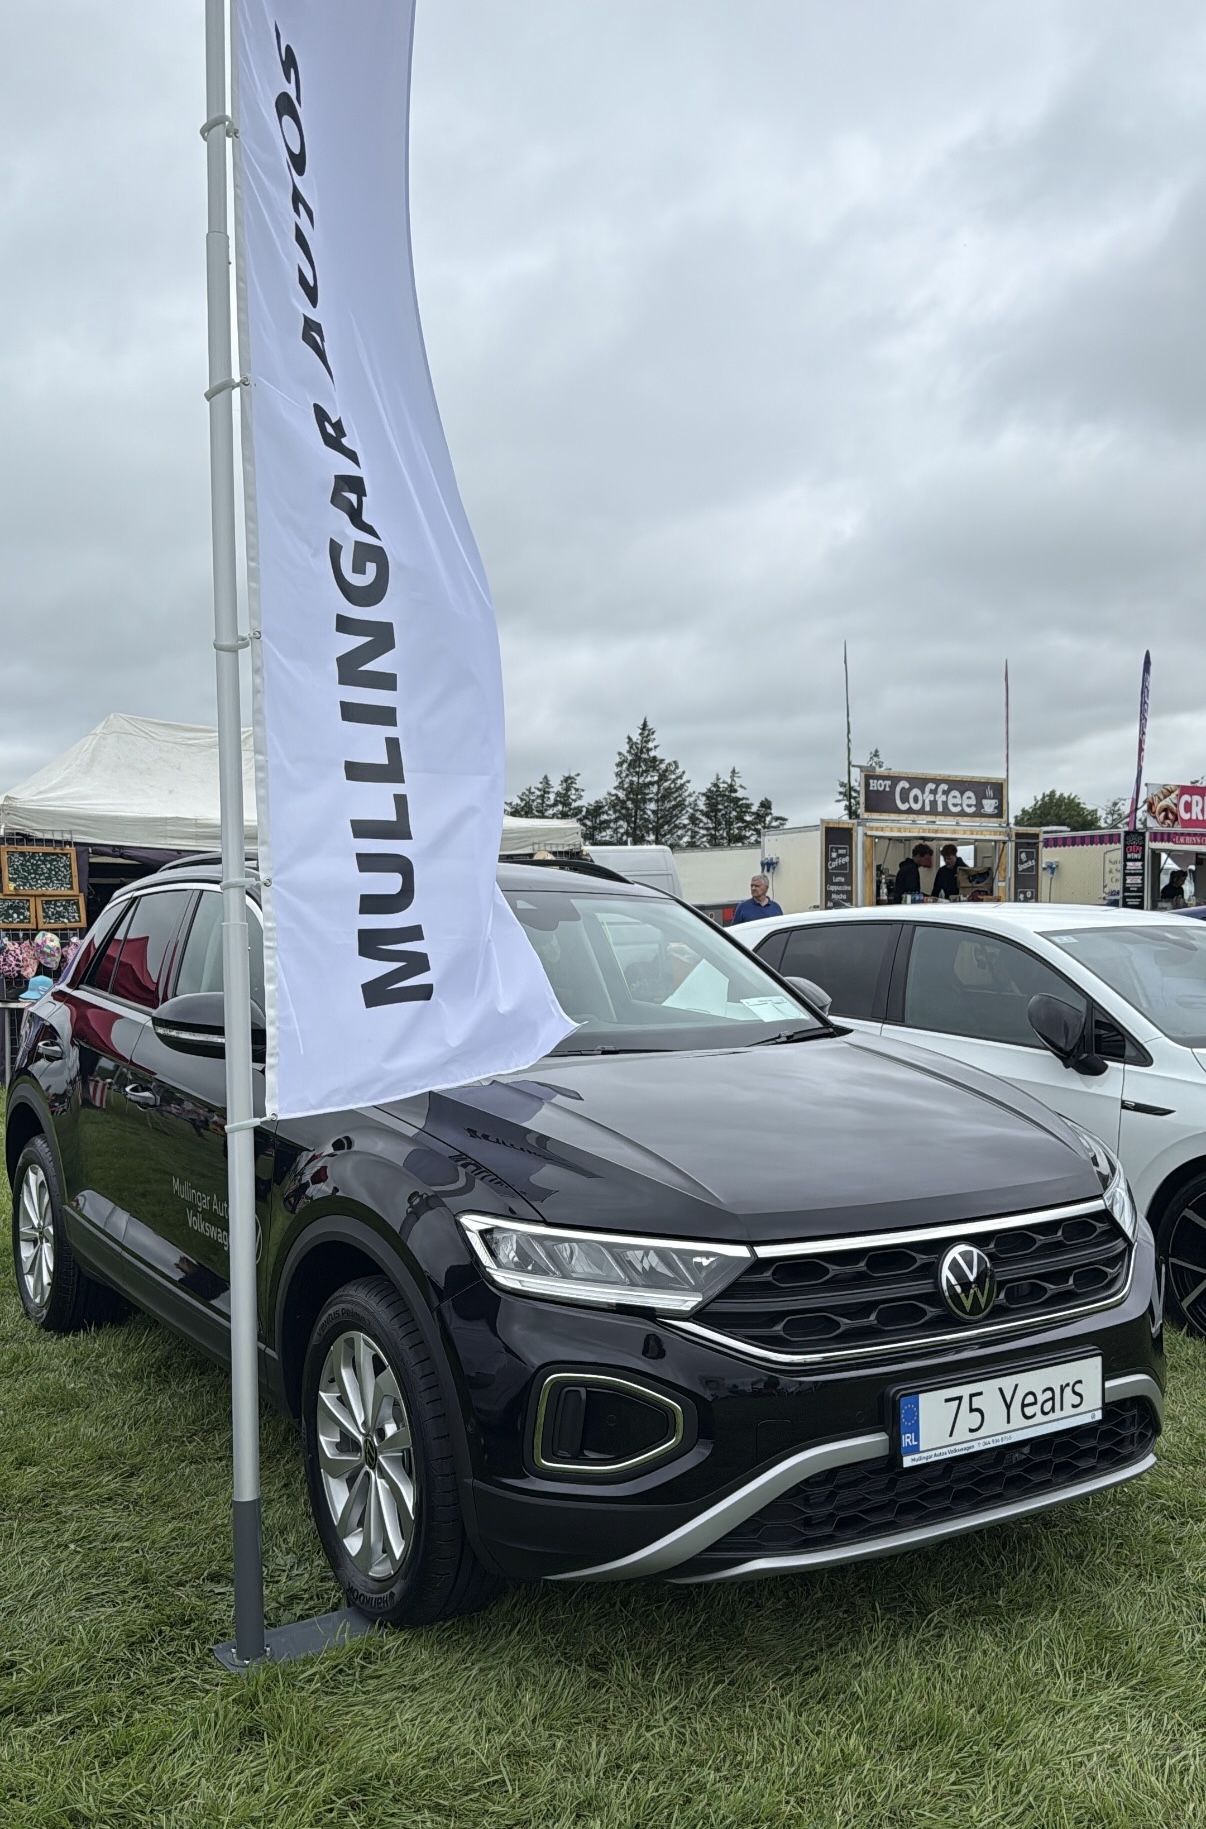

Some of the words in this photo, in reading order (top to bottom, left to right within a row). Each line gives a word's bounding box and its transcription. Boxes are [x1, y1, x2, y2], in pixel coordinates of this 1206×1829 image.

[274, 20, 336, 392] AUTOS
[312, 402, 434, 1009] MULLINGAR
[869, 779, 892, 791] HOT
[895, 780, 977, 813] Coffee
[1179, 794, 1206, 820] CR
[828, 856, 850, 869] Coffee
[1018, 859, 1036, 872] Snacks
[172, 1175, 210, 1212] Mullingar
[212, 1193, 229, 1219] Aut
[186, 1208, 229, 1251] Volkswag
[944, 1390, 985, 1438] 75
[998, 1378, 1084, 1424] Years
[902, 1433, 918, 1447] IRL
[910, 1453, 933, 1464] Mullingar
[933, 1450, 947, 1459] Autos
[947, 1444, 975, 1455] Volkswagen
